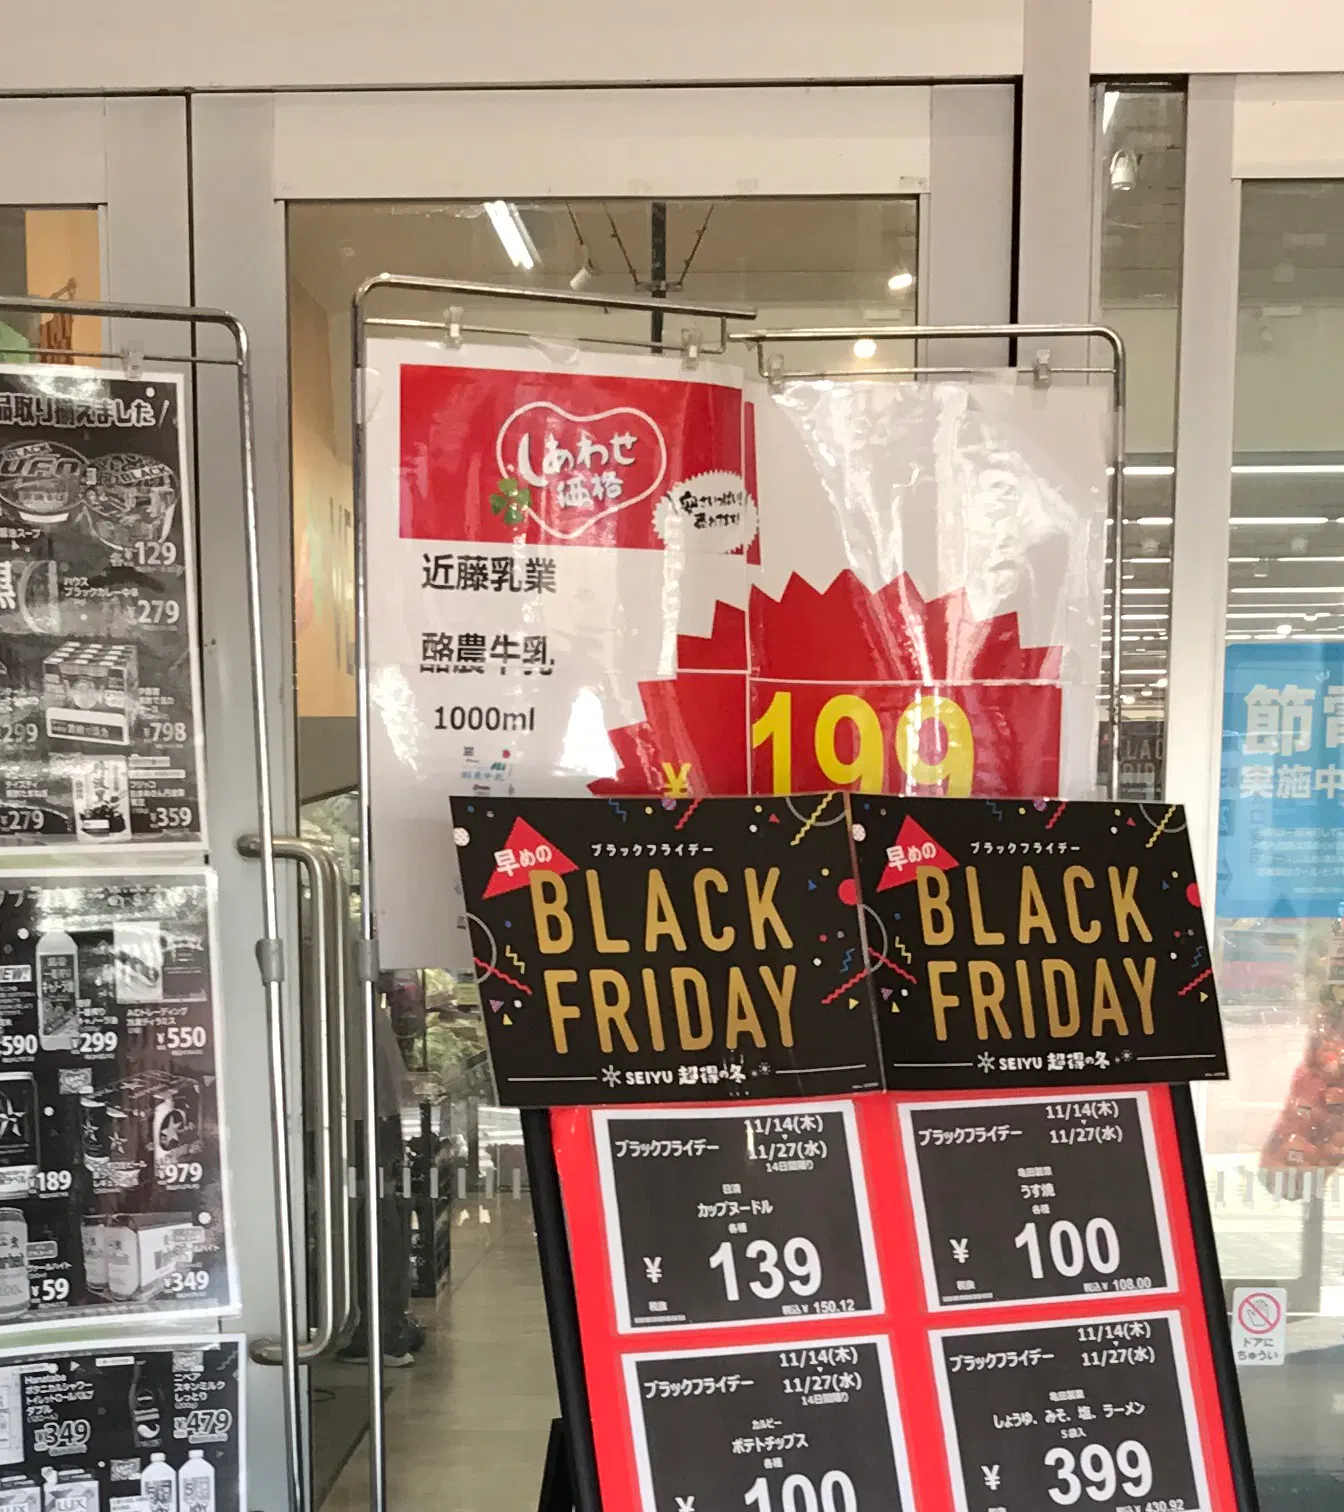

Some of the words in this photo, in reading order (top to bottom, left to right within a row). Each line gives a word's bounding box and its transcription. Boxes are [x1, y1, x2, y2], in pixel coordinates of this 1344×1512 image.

[555, 471, 624, 510] 価格
[135, 542, 177, 565] 129
[420, 553, 557, 594] 近藤乳業
[137, 600, 179, 624] 279
[419, 632, 556, 676] 酪農牛乳
[433, 706, 536, 734] 1000ml
[3, 723, 38, 743] 299
[151, 723, 187, 743] 798
[752, 692, 975, 801] 199
[9, 811, 44, 830] 279
[158, 807, 192, 827] 359
[591, 843, 714, 858] ブラックフライデー
[886, 842, 937, 872] 早めの
[971, 842, 1080, 855] ブラックフライデー
[494, 844, 552, 877] 早めの
[529, 867, 794, 954] BLACK
[916, 865, 1153, 946] BLACK
[544, 965, 797, 1054] FRIDAY
[927, 957, 1156, 1041] FRIDAY
[80, 1032, 118, 1052] 299
[167, 1027, 207, 1049] 550
[998, 1056, 1043, 1072] SEIYU
[625, 1070, 674, 1086] SEIYU
[1045, 1101, 1119, 1120] 11/14(木)
[743, 1115, 824, 1135] 11/14(木)
[918, 1125, 1022, 1146] ブラックフライデー
[1049, 1125, 1123, 1145] 11/27(水)
[615, 1138, 720, 1158] ブラックフライデー
[748, 1141, 827, 1160] 11/27(水)
[36, 1171, 72, 1191] 189
[166, 1164, 203, 1183] 979
[1020, 1183, 1055, 1199] うす焼
[697, 1200, 773, 1219] カップヌードル
[1015, 1217, 1120, 1279] 100
[709, 1237, 823, 1301] 139
[42, 1278, 70, 1300] 59
[172, 1272, 209, 1290] 349
[813, 1299, 855, 1313] 150.12
[1077, 1322, 1151, 1342] 11/14(木)
[1243, 1337, 1274, 1347] ドアに
[779, 1347, 858, 1368] 11/14(木)
[949, 1348, 1055, 1373] ブラックフライデー
[1081, 1346, 1156, 1367] 11/27(水)
[644, 1375, 755, 1399] ブラックフライデー
[783, 1372, 862, 1394] 11/27(水)
[1103, 1401, 1145, 1417] ラーメン
[732, 1432, 808, 1454] ポテトチップス
[1044, 1440, 1153, 1506] 399
[58, 1499, 83, 1511] LUX
